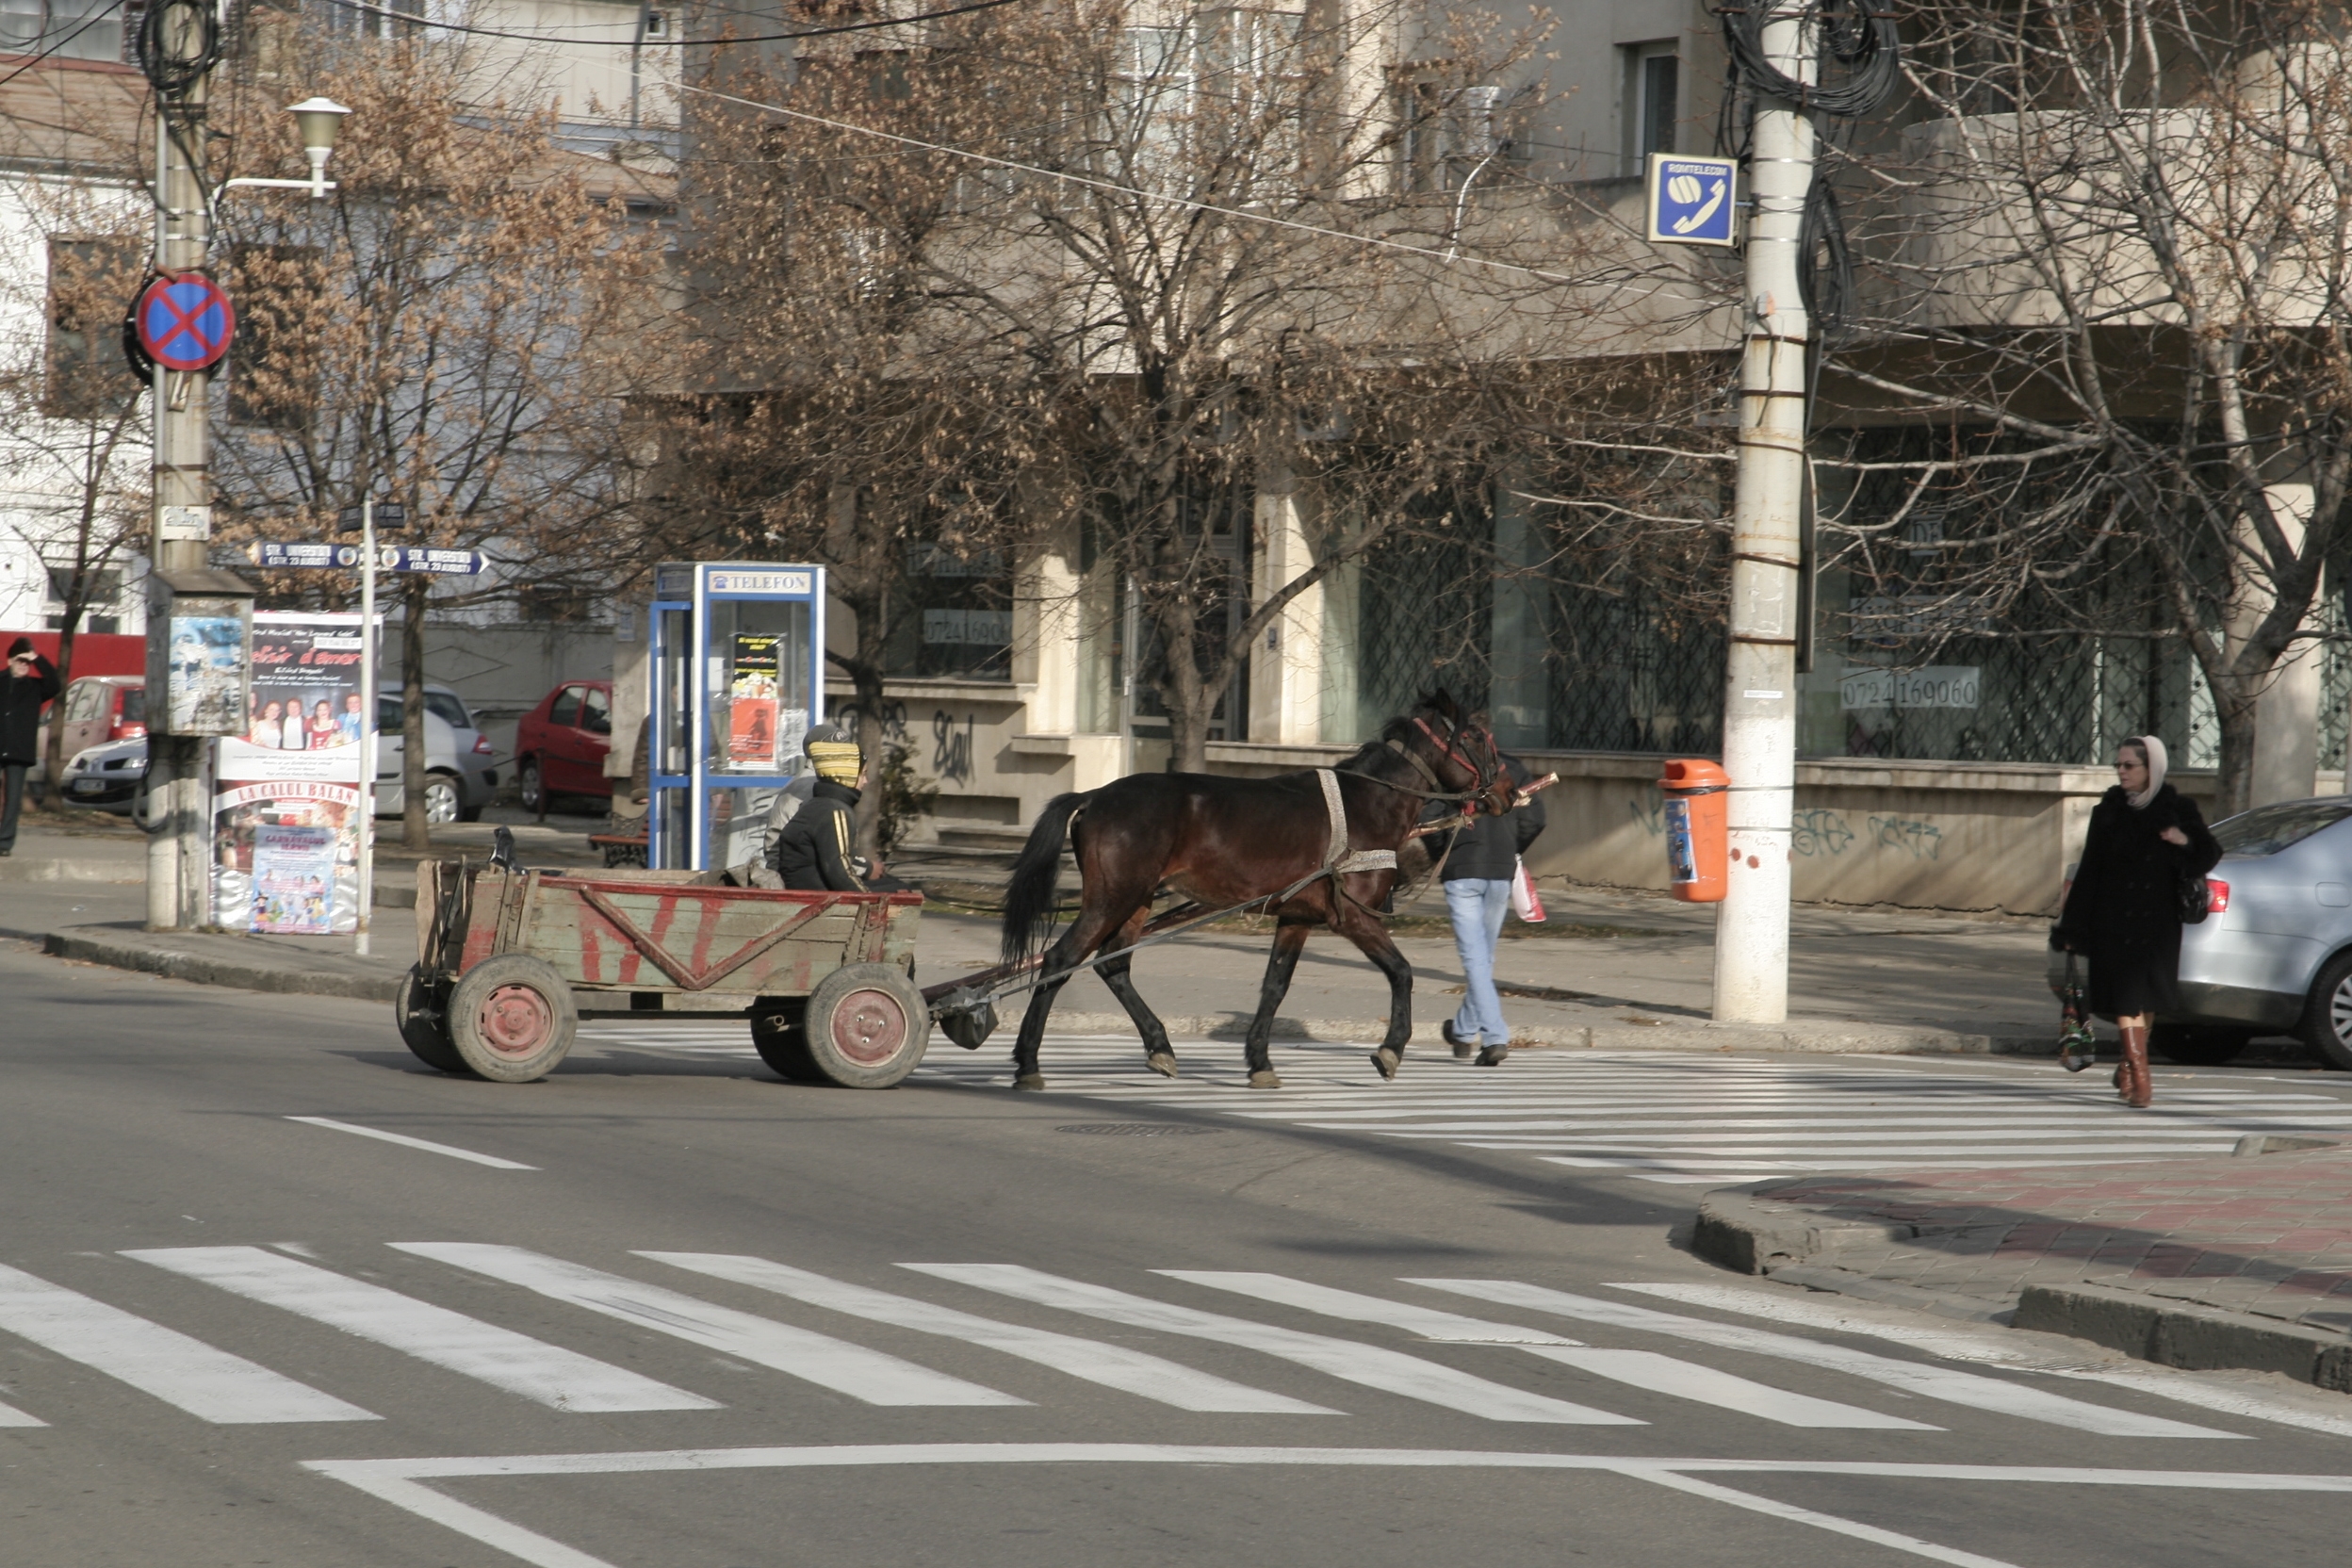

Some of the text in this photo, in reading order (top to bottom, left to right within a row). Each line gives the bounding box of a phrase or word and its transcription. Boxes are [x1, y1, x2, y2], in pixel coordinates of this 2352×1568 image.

[1668, 163, 1727, 176] ROMTELECOM
[731, 576, 807, 589] TELEFON
[237, 788, 256, 802] LA
[260, 783, 303, 798] CALUL
